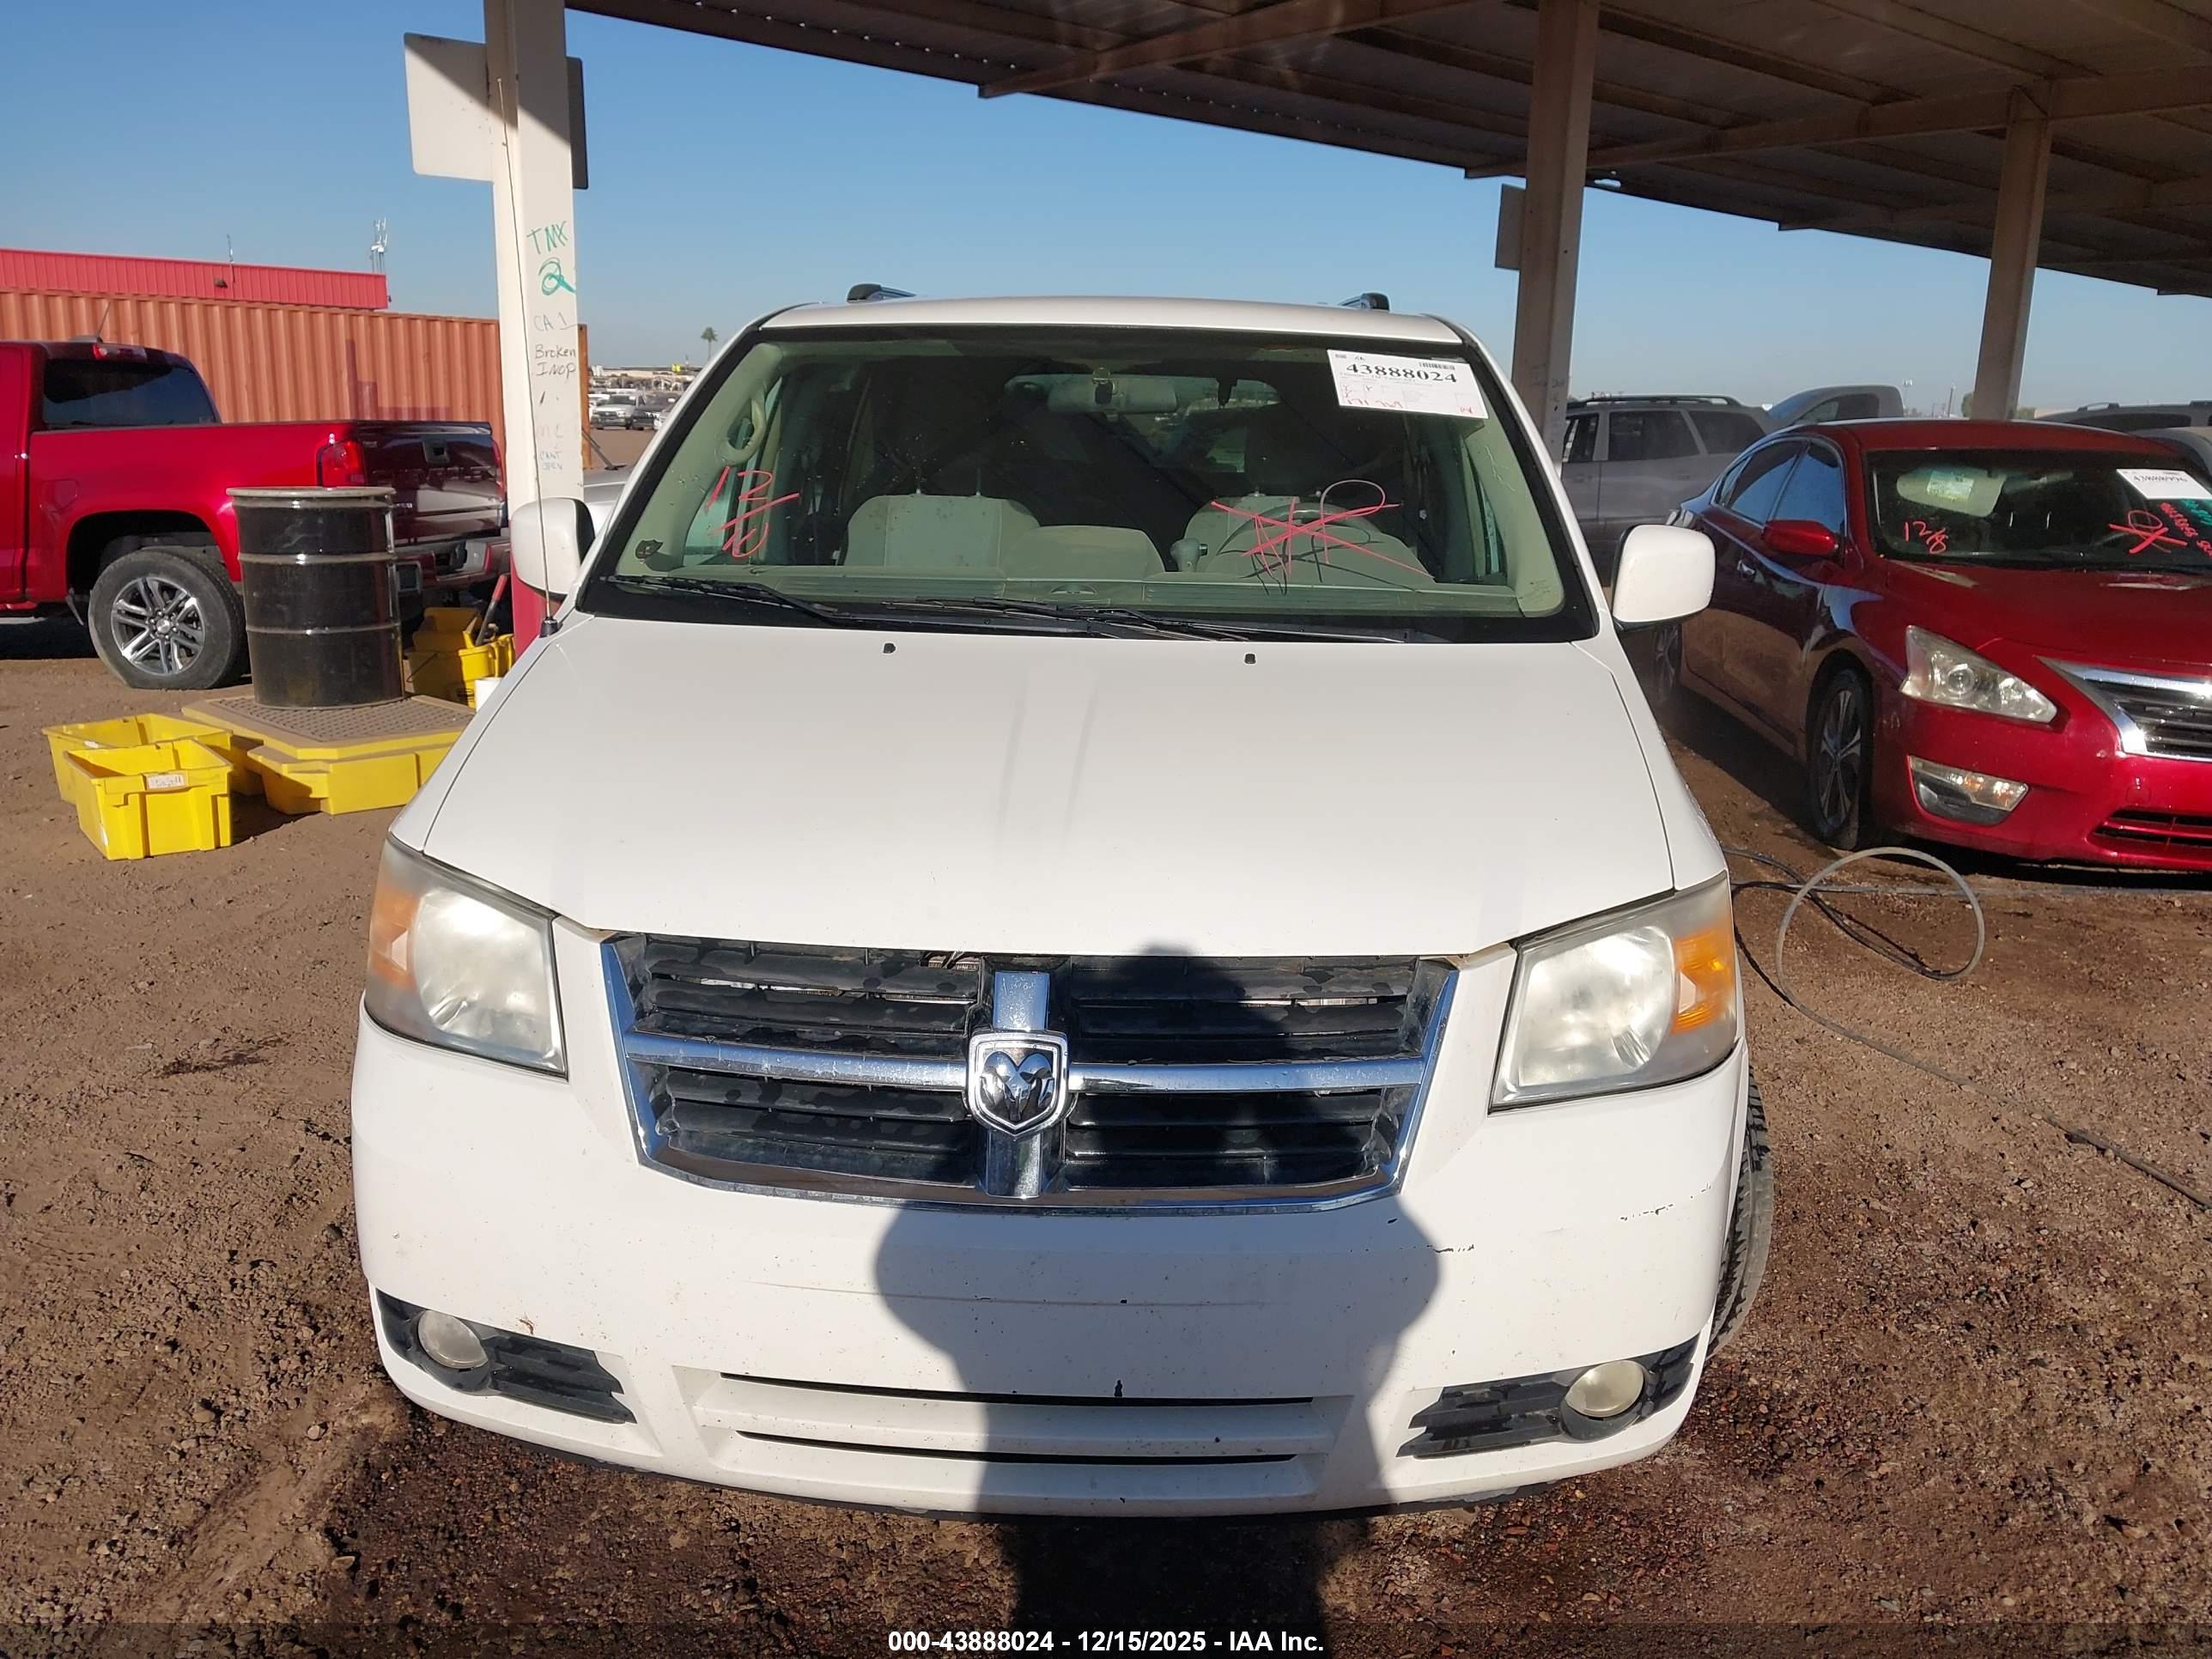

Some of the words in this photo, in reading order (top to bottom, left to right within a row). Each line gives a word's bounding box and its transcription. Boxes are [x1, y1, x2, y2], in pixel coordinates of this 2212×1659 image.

[538, 257, 575, 296] 2
[534, 343, 576, 359] Broken
[1346, 363, 1457, 383] 43888024
